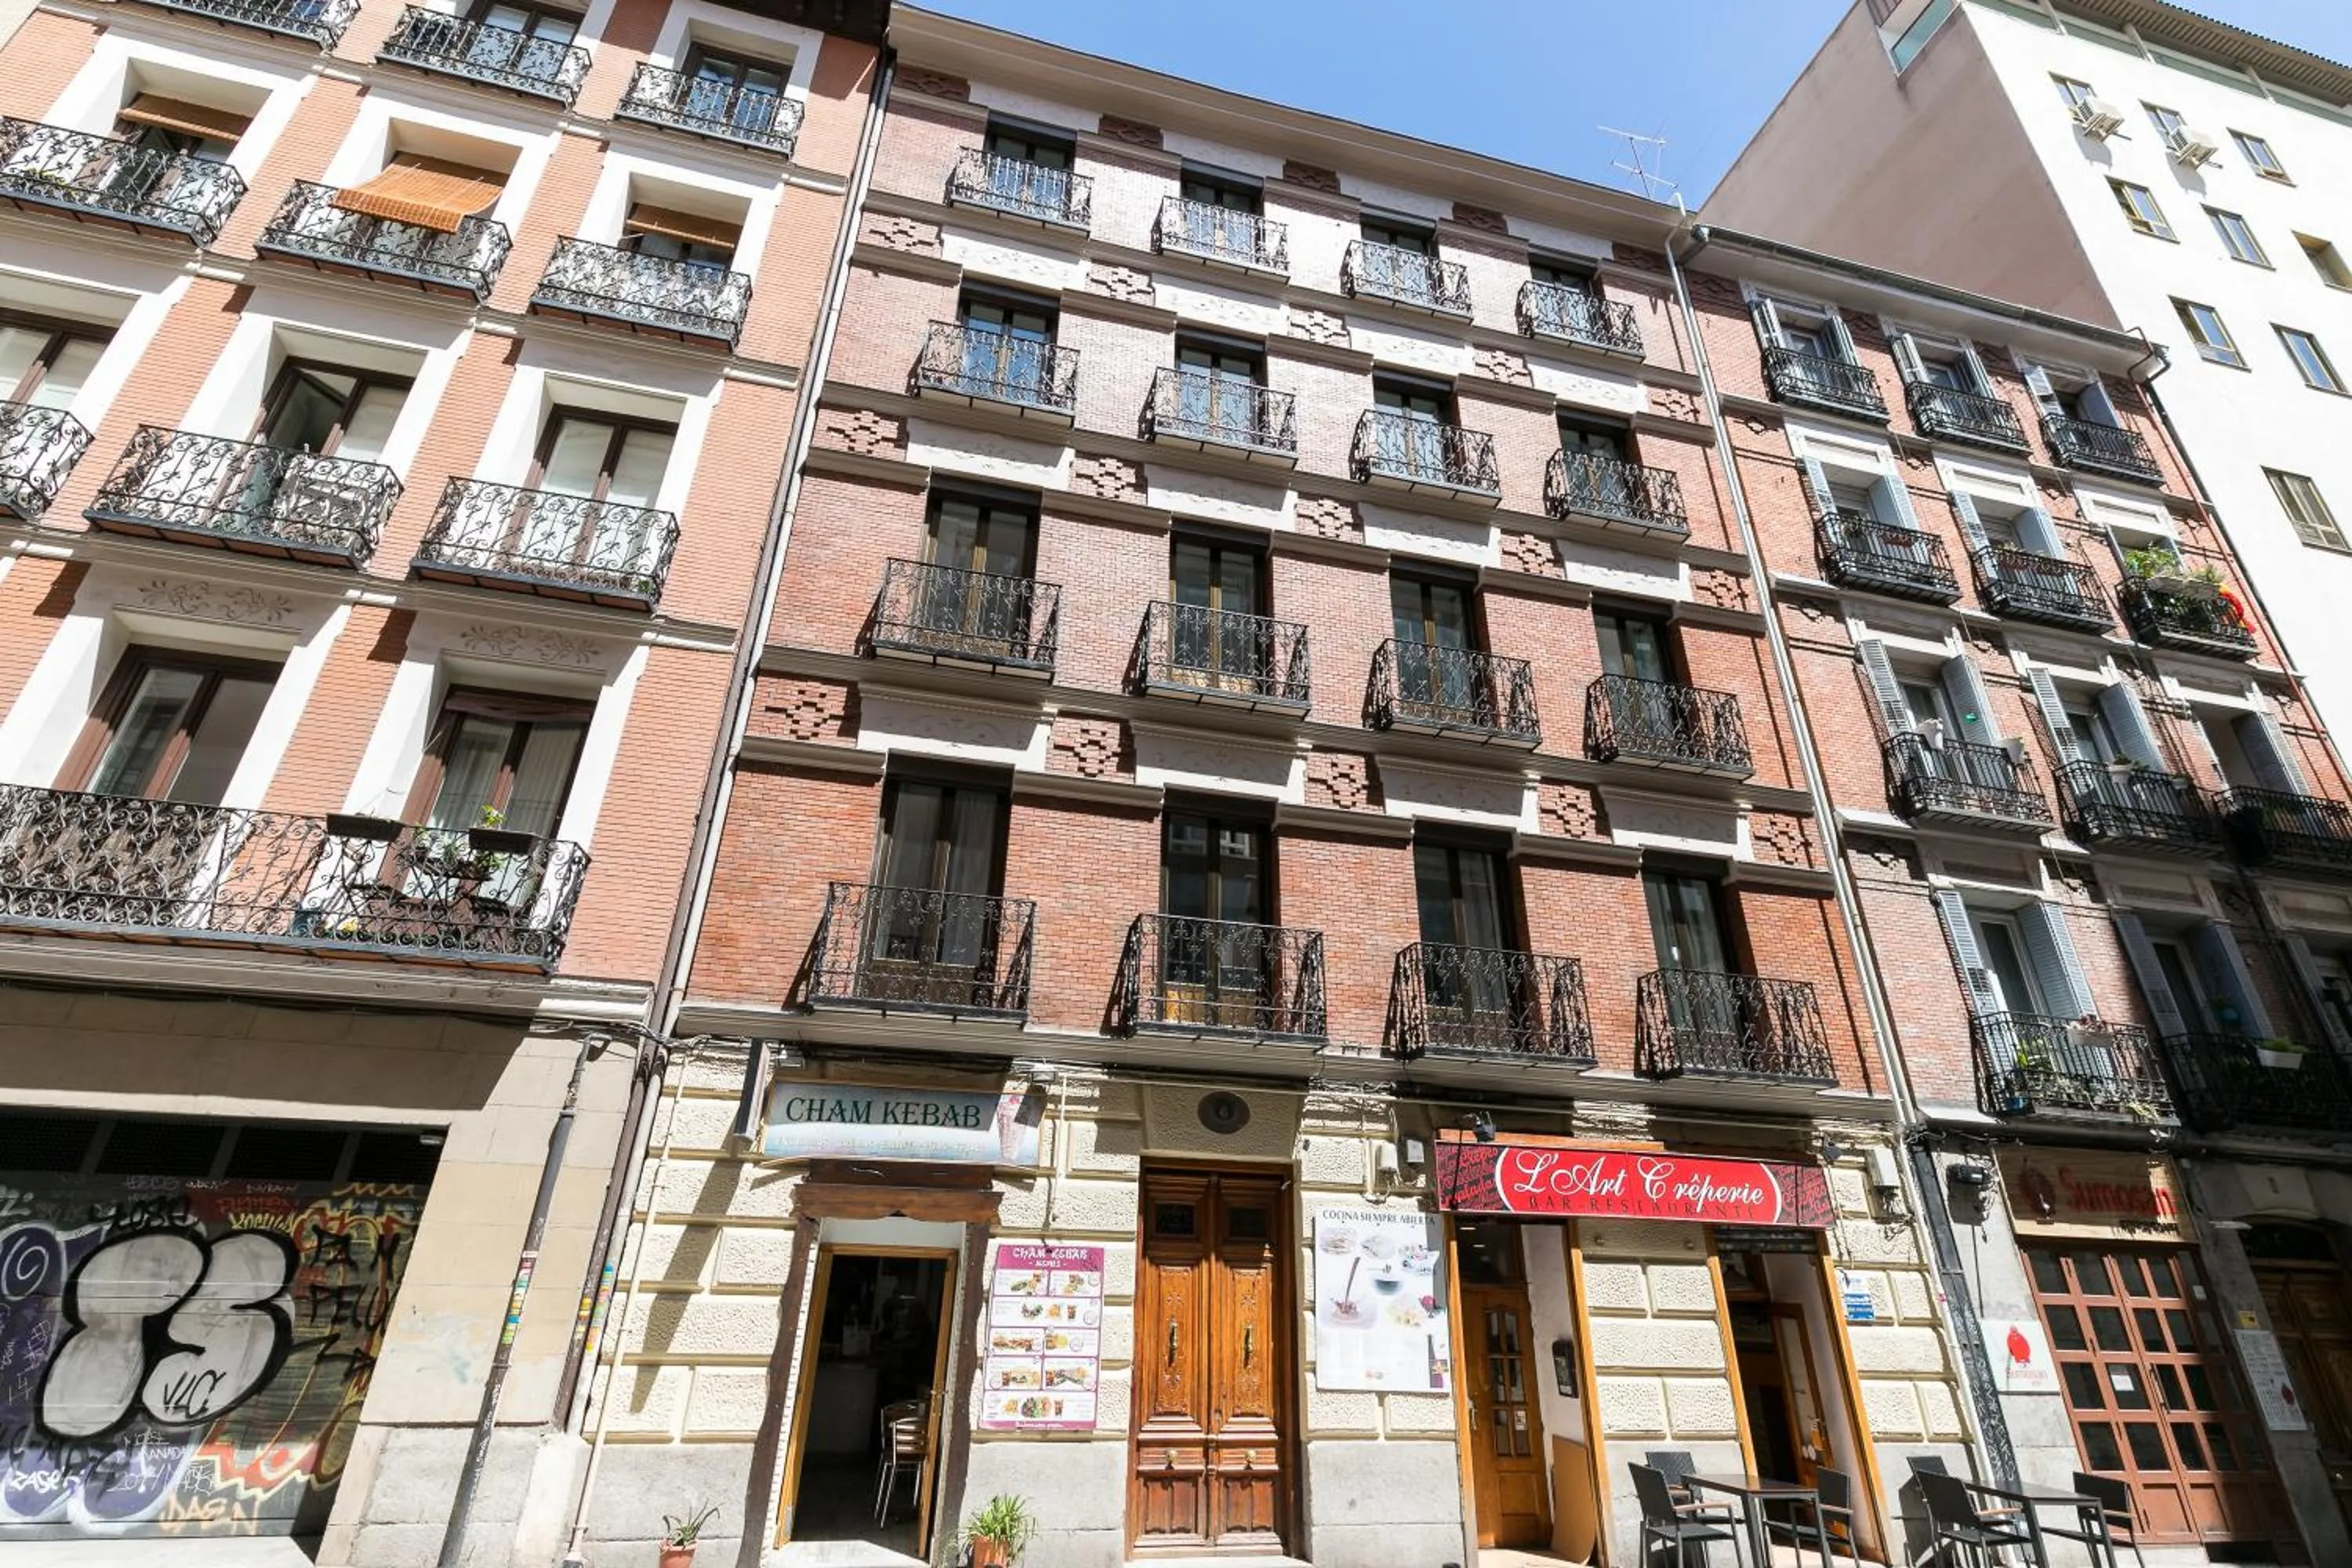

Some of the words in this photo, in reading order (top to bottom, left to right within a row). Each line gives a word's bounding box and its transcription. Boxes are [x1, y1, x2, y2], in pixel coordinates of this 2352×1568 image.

[786, 1097, 873, 1124] CHAM
[883, 1102, 980, 1127] KEBAB
[1514, 1149, 1627, 1196] L'Art
[1636, 1156, 1764, 1213] Crêperie
[1323, 1210, 1358, 1220] COCINA
[1360, 1211, 1399, 1222] SIEMPRE
[1400, 1214, 1436, 1225] ABIERTA
